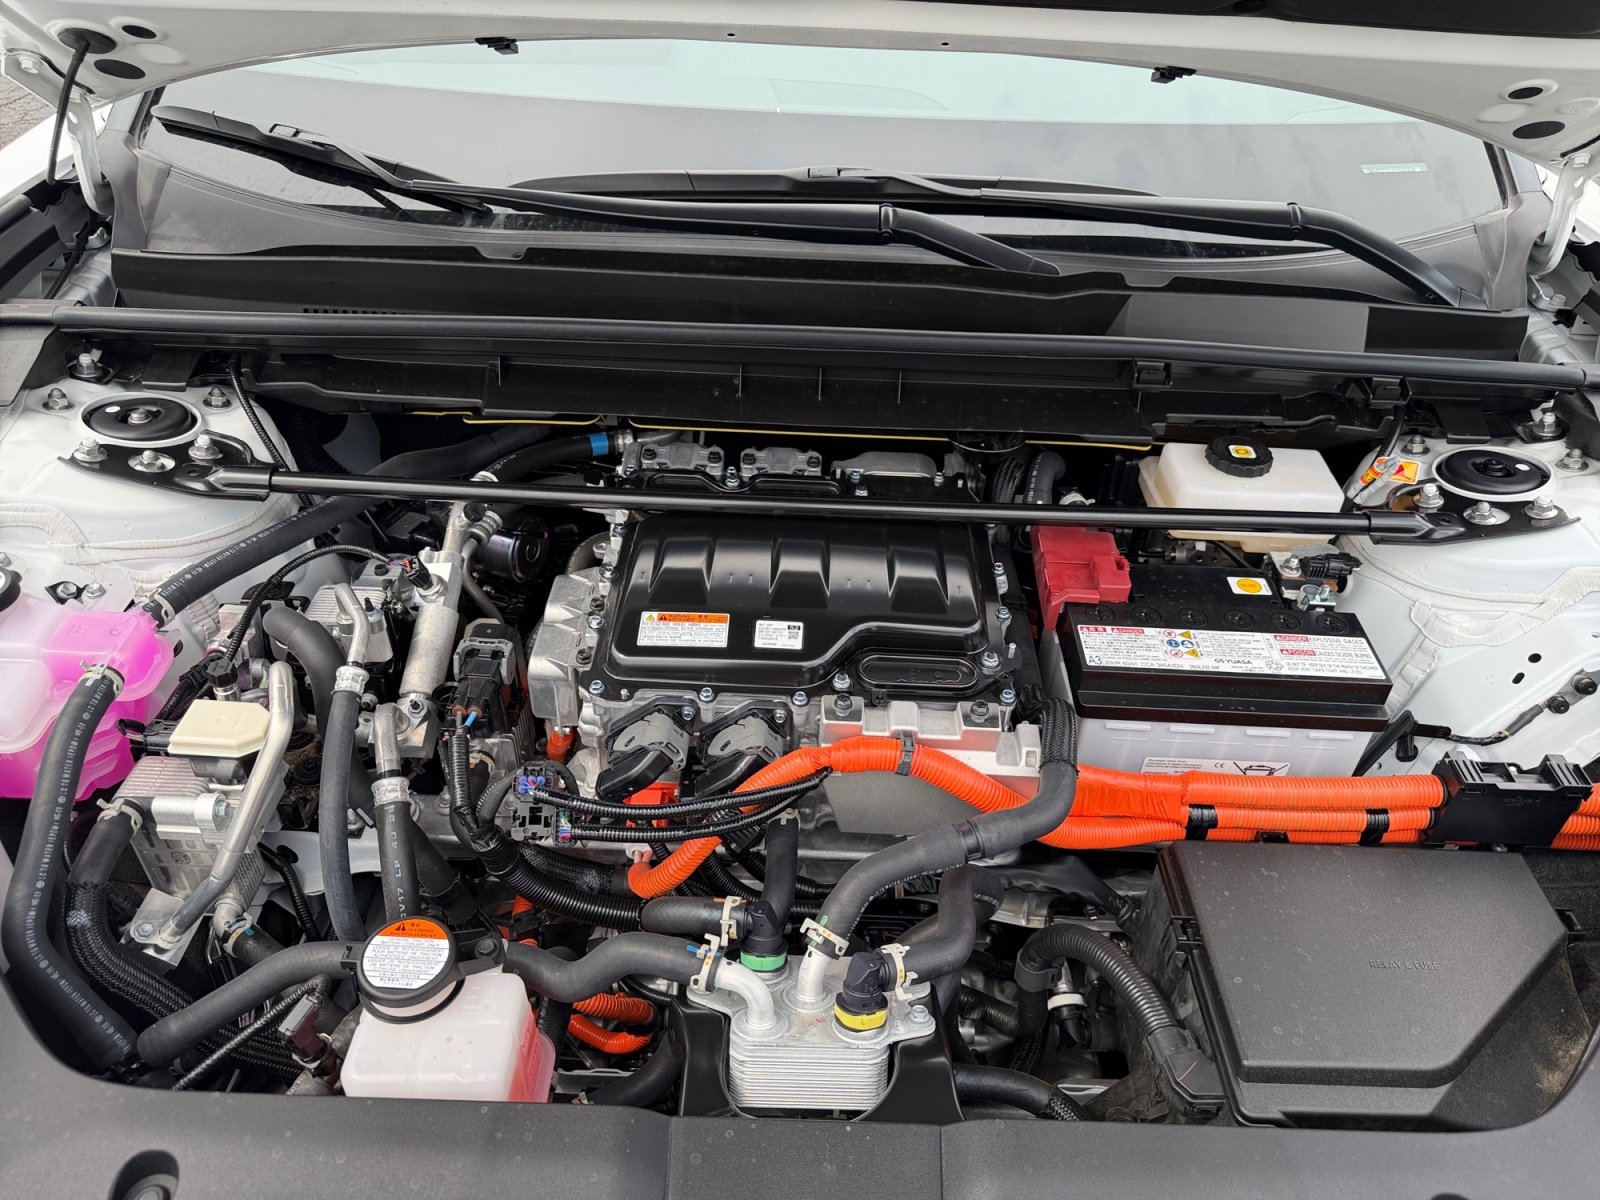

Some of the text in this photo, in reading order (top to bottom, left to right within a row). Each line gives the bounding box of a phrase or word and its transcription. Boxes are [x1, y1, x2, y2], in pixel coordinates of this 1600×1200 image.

[1088, 655, 1102, 665] A3
[390, 831, 397, 848] 4J
[394, 861, 401, 877] LP
[1369, 960, 1440, 970] RELAY & FUSE
